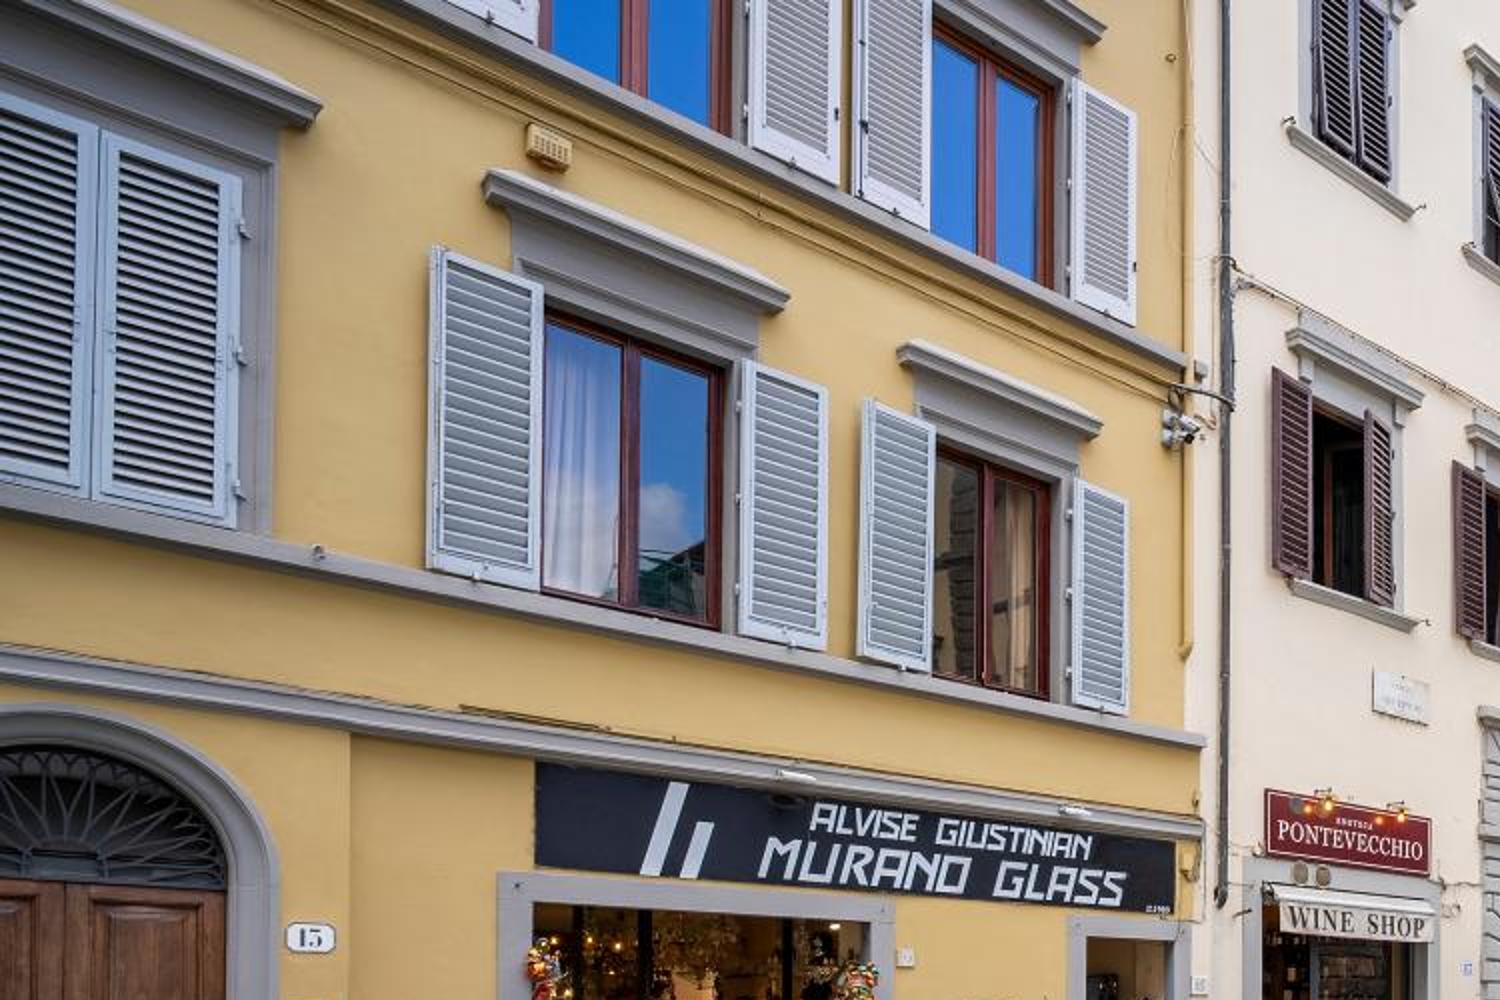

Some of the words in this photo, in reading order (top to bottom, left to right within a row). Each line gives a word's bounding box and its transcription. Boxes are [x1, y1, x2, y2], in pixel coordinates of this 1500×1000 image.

[808, 802, 920, 842] ALVISE
[935, 817, 1094, 861] GIUSTINIAN
[1276, 819, 1423, 861] PONTEVECCHIO
[757, 836, 973, 895] MURANO
[992, 861, 1128, 907] GLASS
[300, 928, 322, 947] 15
[1288, 905, 1355, 933] WINE
[1367, 913, 1425, 939] SHOP
